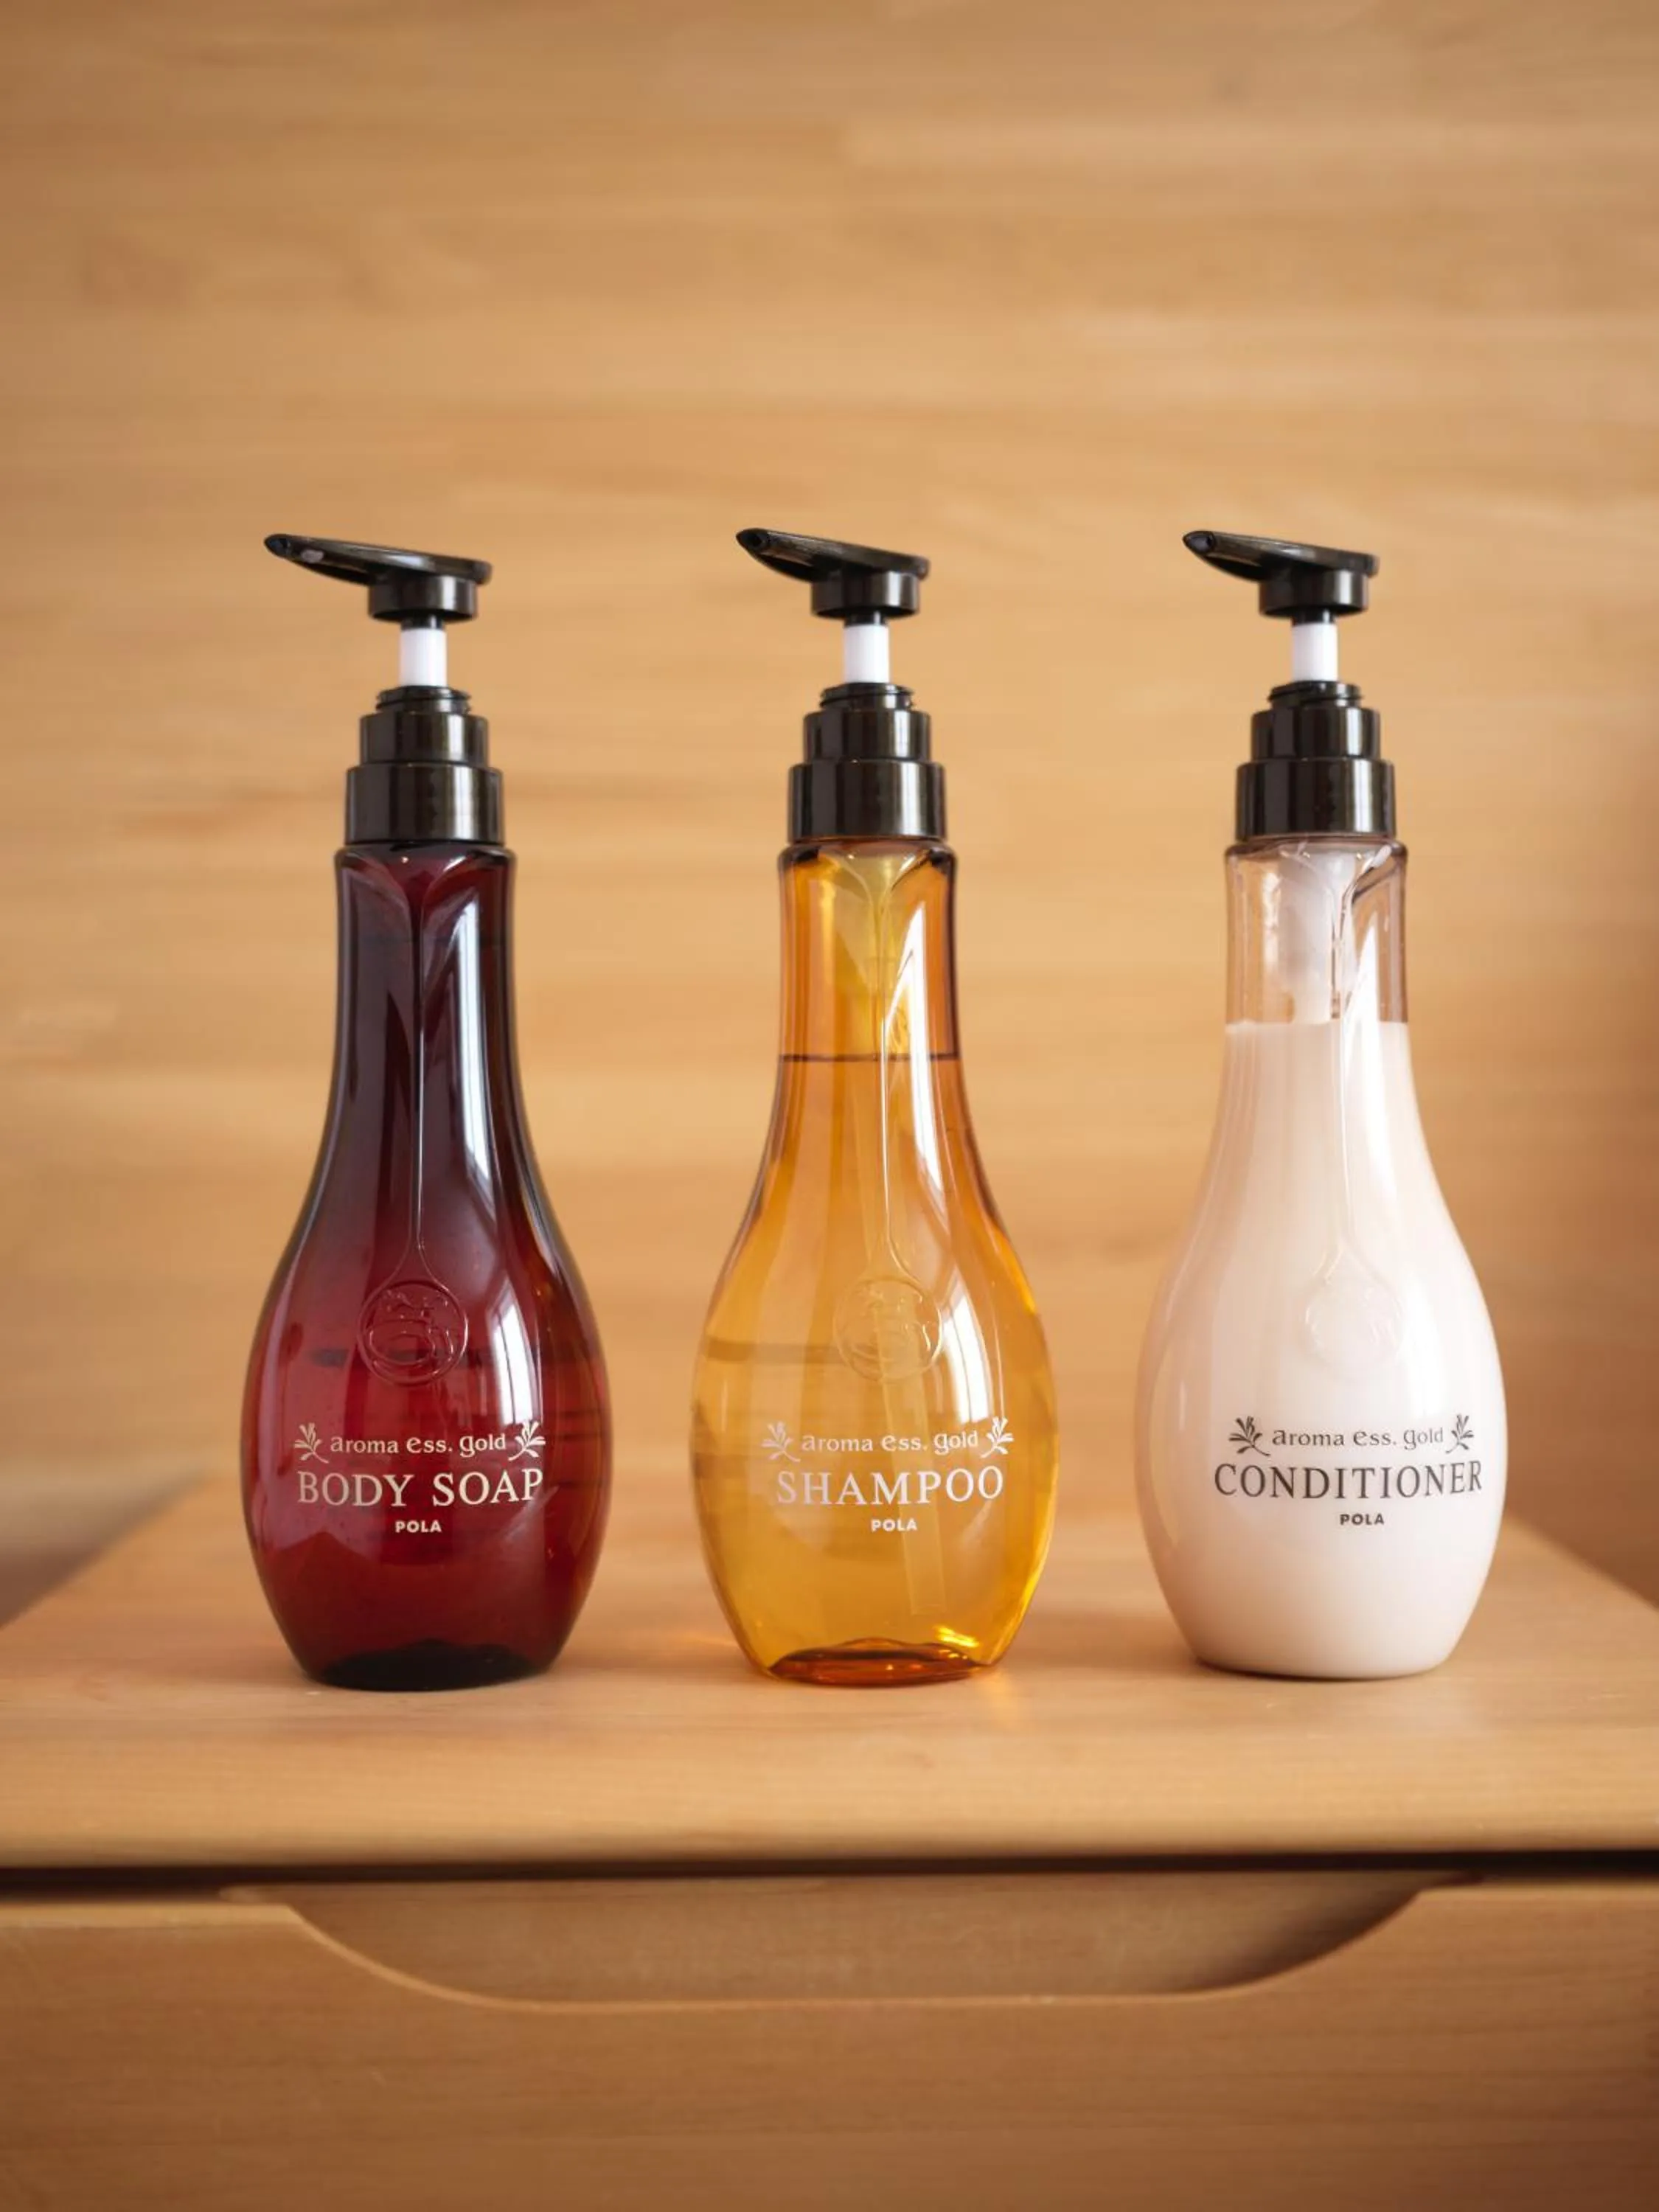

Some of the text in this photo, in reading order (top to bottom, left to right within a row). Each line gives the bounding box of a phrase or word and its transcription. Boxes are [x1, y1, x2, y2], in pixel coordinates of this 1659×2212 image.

[330, 1433, 506, 1458] aroma ess. gold
[801, 1430, 978, 1455] aroma ess. gold
[1272, 1427, 1444, 1450] aroma ess. gold
[296, 1467, 543, 1507] BODY SOAP
[777, 1465, 1004, 1505] SHAMPOO
[1214, 1460, 1483, 1499] CONDITIONER
[394, 1520, 442, 1534] POLA
[871, 1518, 917, 1532] POLA
[1339, 1513, 1385, 1526] POLA
